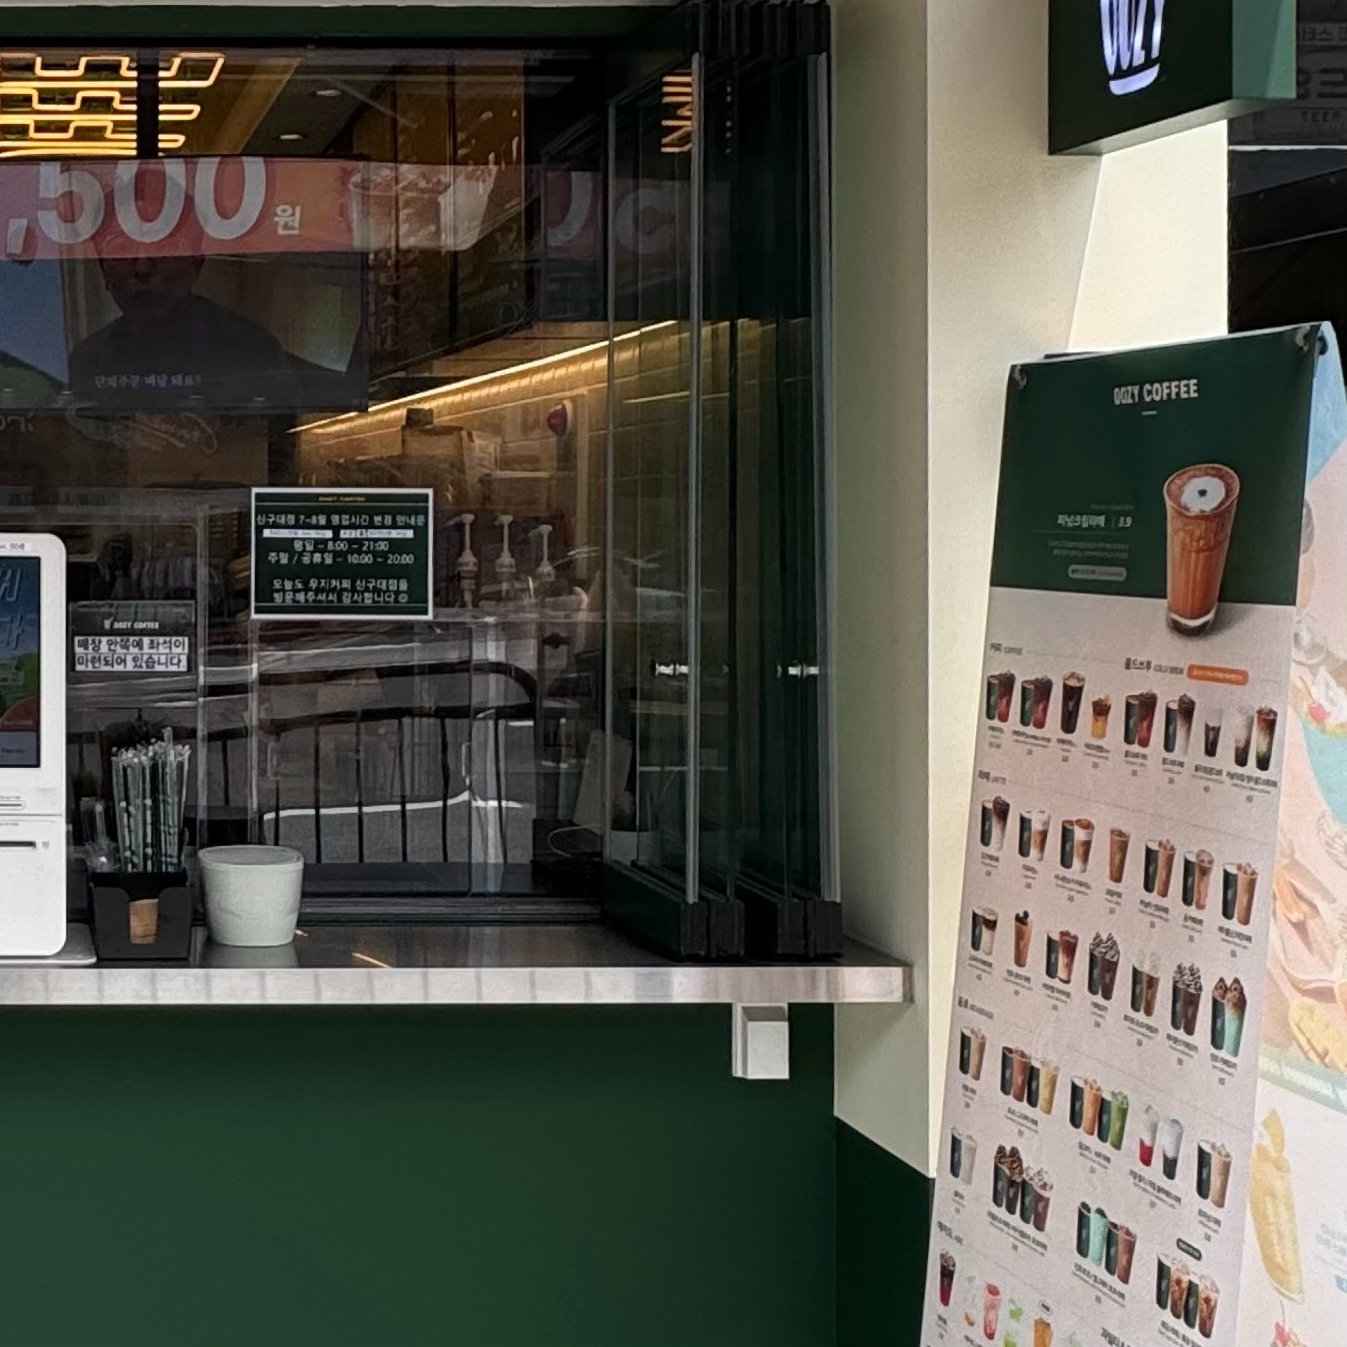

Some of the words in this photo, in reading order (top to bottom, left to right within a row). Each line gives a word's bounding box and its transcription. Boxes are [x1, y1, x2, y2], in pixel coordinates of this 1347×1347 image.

[1113, 384, 1140, 406] OOZY
[1143, 378, 1199, 403] COFFEE
[77, 637, 102, 652] 매장
[106, 637, 144, 653] 안쪽에
[147, 637, 185, 653] 좌석이
[77, 653, 127, 669] 마련되어
